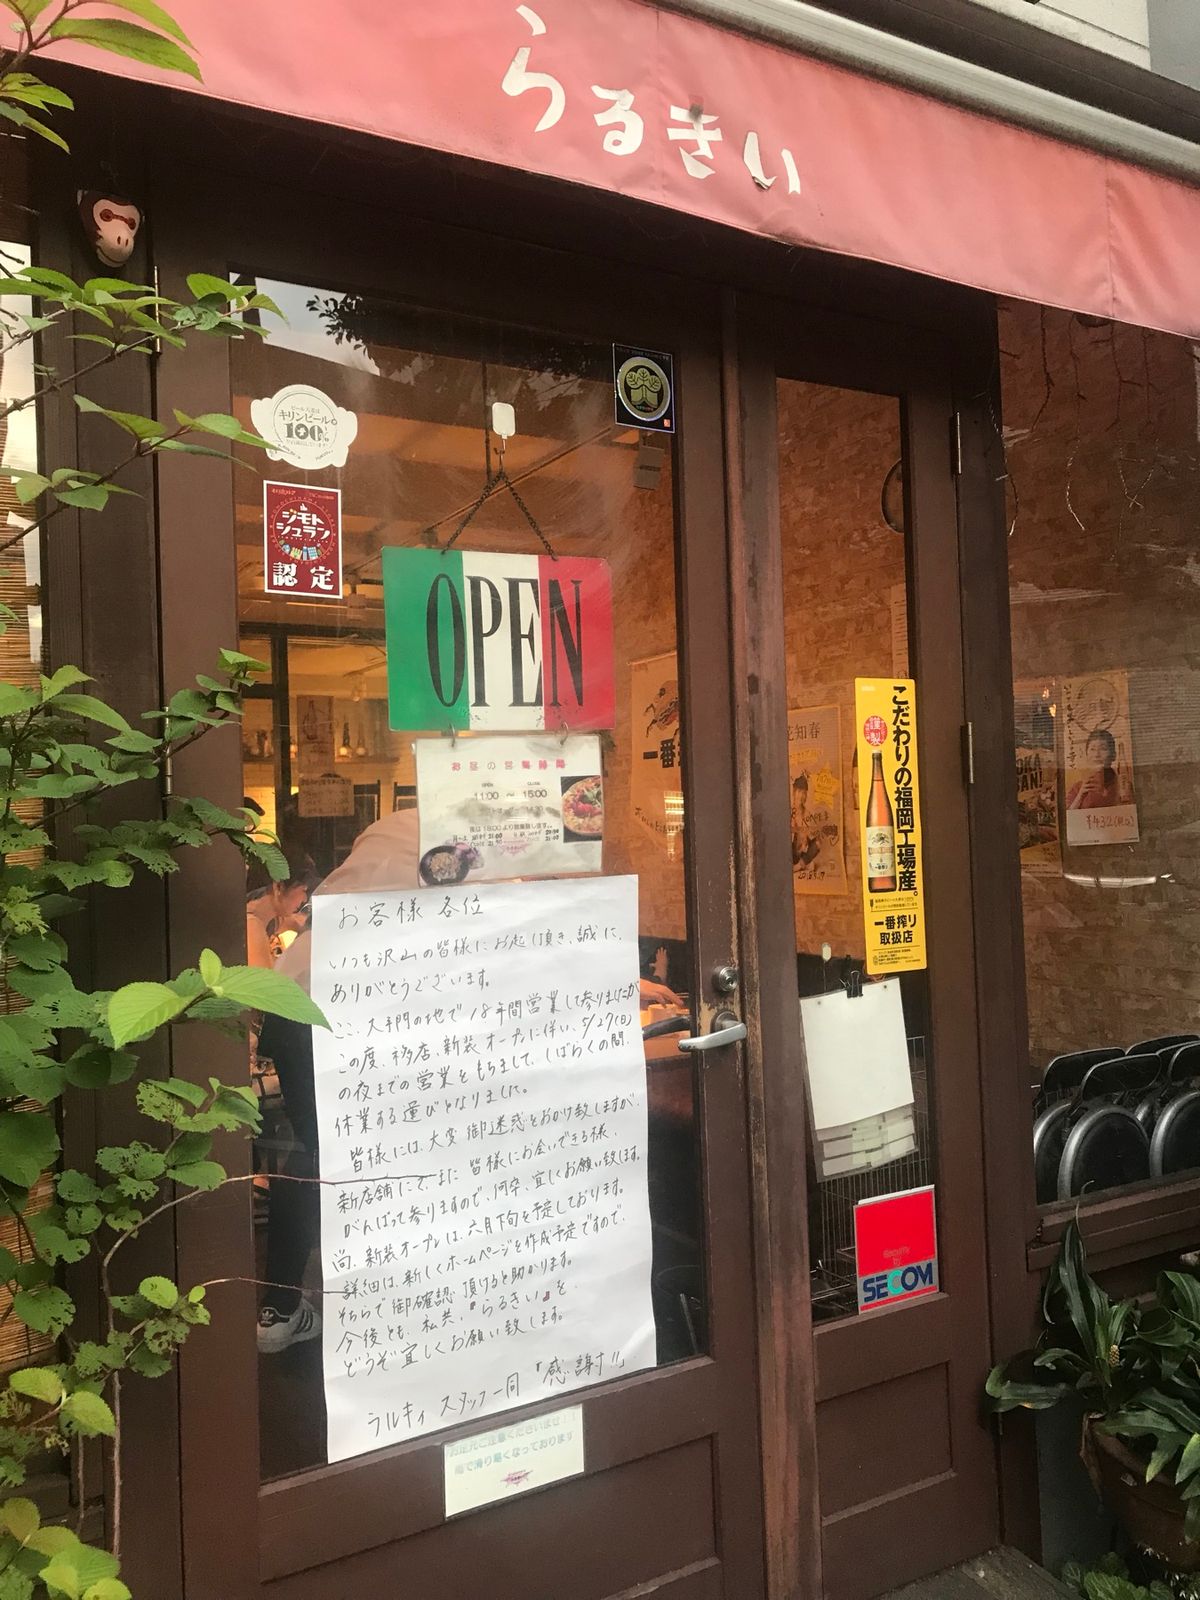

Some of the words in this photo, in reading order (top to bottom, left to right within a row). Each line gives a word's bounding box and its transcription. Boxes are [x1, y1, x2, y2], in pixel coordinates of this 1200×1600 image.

[501, 4, 801, 195] らるきい
[279, 409, 330, 424] キリンビール
[282, 508, 325, 525] ジモト
[276, 522, 331, 540] シュラン
[273, 562, 334, 590] 認定
[426, 573, 583, 708] OPEN
[1016, 753, 1041, 775] OKA
[892, 685, 919, 897] こだわりの福岡工場産。
[874, 914, 917, 930] 一番搾り
[880, 930, 913, 946] 取扱店
[862, 1262, 934, 1303] SECOM
